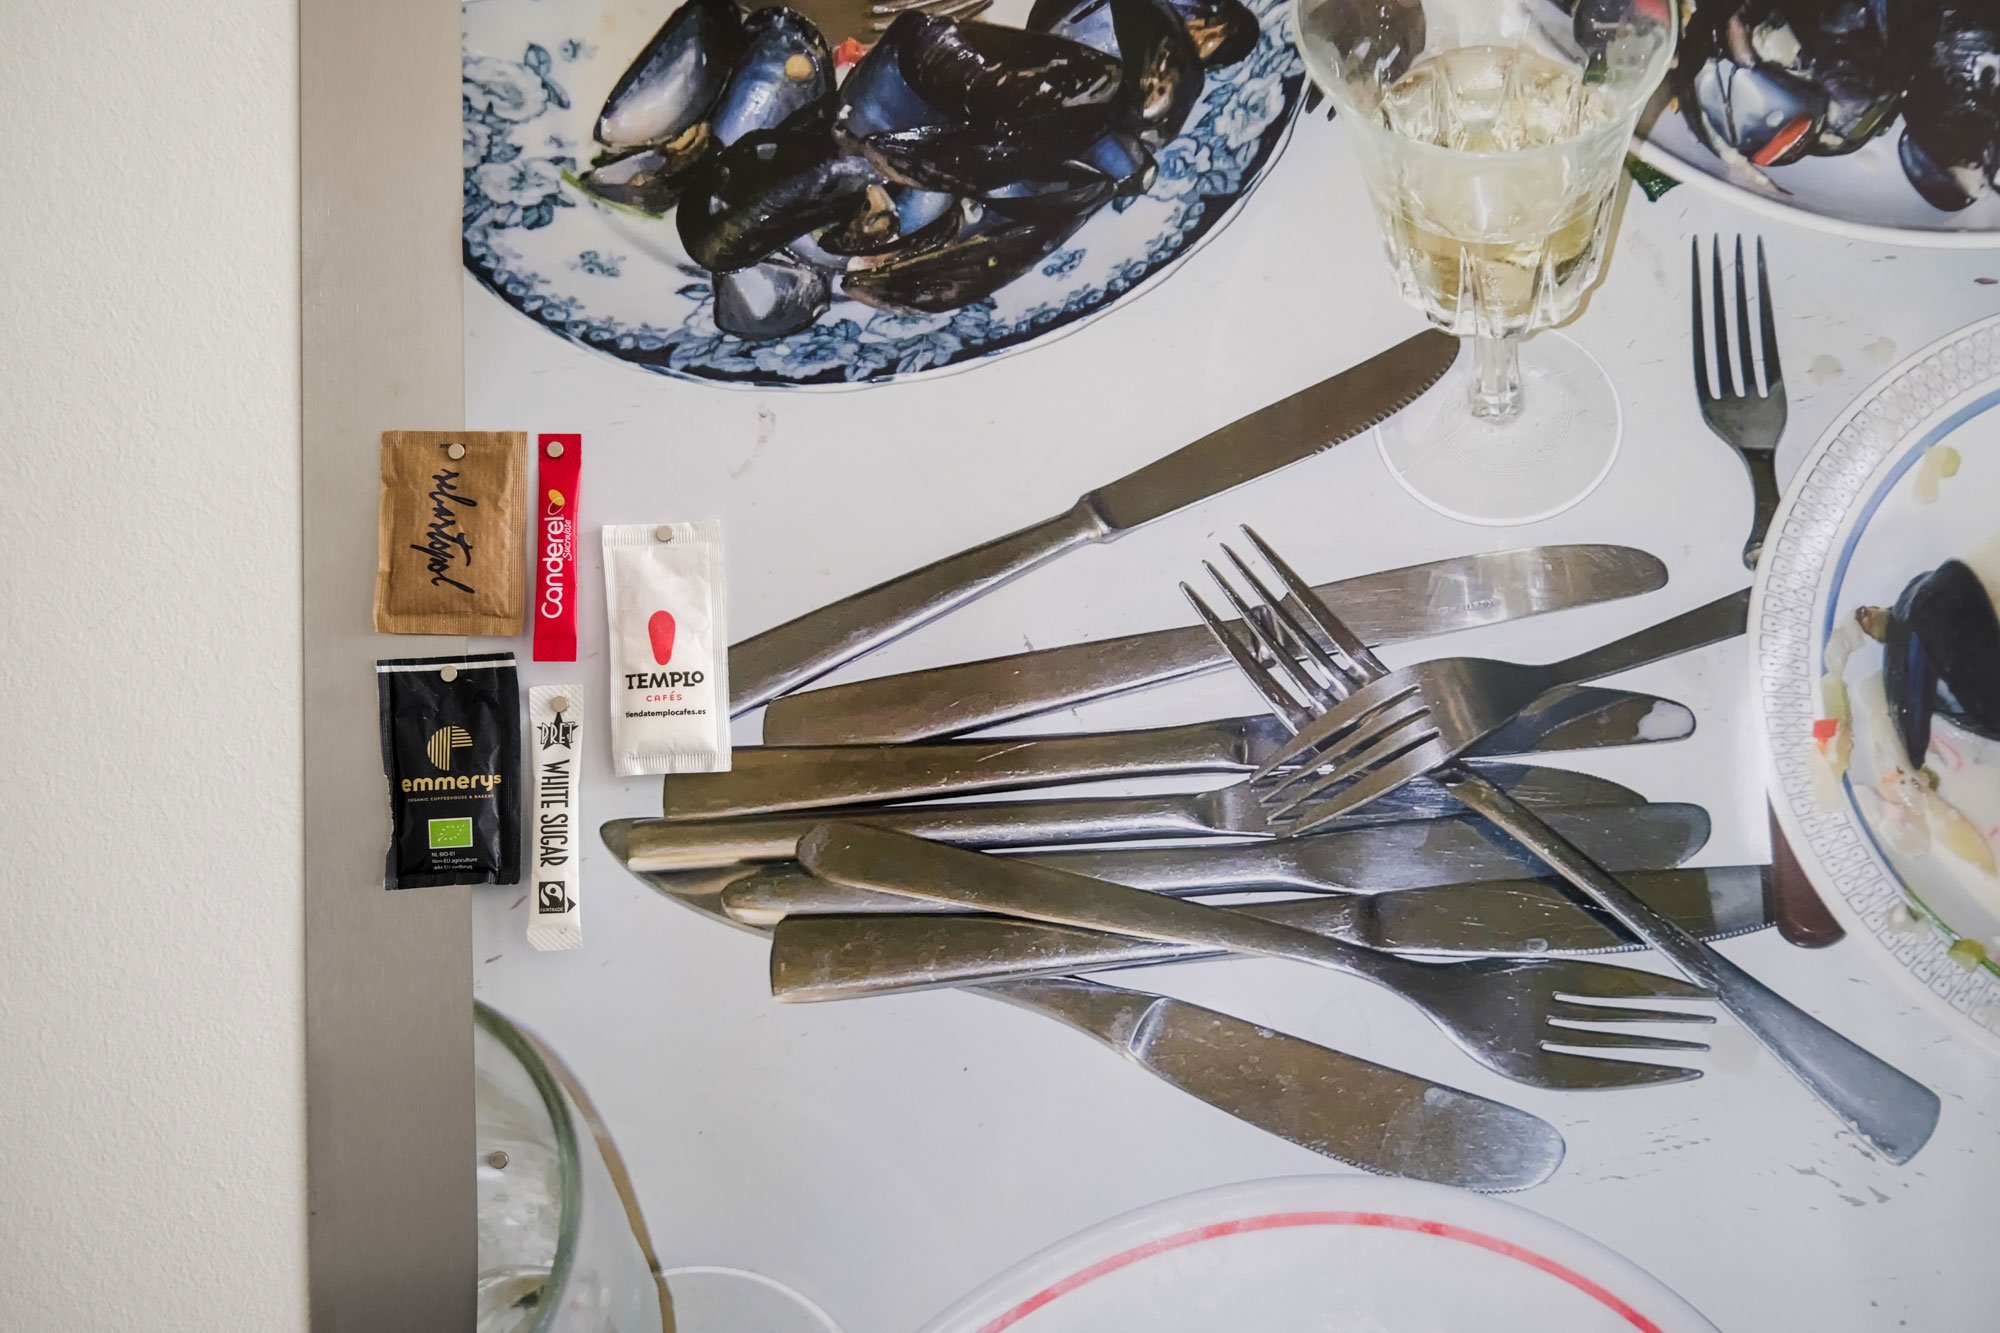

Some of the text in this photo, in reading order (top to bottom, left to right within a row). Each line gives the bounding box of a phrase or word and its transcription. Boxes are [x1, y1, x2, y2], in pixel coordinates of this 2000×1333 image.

[563, 519, 572, 562] Sucralose
[541, 516, 564, 618] Canderel
[625, 671, 704, 689] TEMPLO
[646, 691, 682, 702] CAFÉS
[625, 708, 706, 718] tiendatemplocafes.es
[540, 721, 575, 745] PRET
[401, 774, 502, 793] emmerys
[540, 759, 570, 868] WHITE SUGAR
